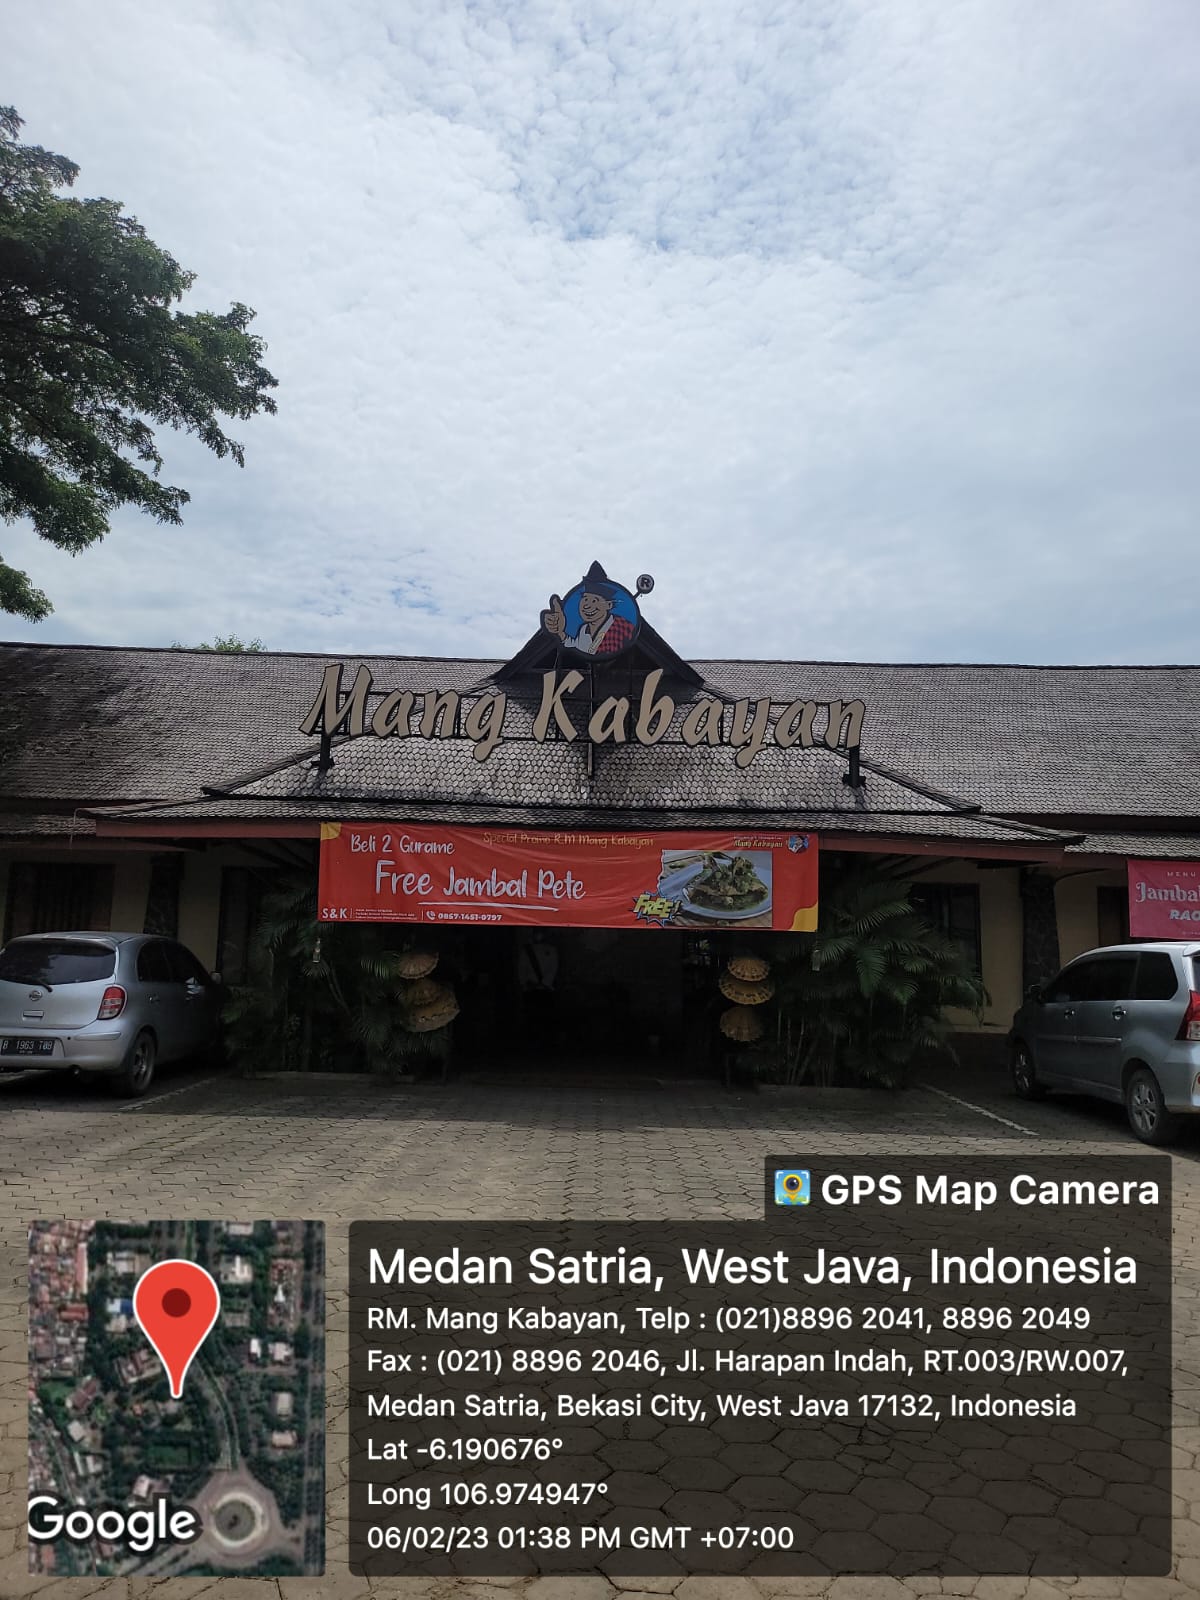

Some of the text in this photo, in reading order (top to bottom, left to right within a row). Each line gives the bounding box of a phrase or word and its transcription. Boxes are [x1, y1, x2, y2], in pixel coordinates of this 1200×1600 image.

[300, 663, 867, 768] Mang Kabayan
[351, 834, 456, 855] Beli 2 Gurame
[483, 832, 518, 846] Special
[520, 832, 551, 846] Promo
[578, 834, 608, 849] Mang
[611, 834, 654, 850] Kabayan
[375, 859, 587, 900] Free Jambal Pete
